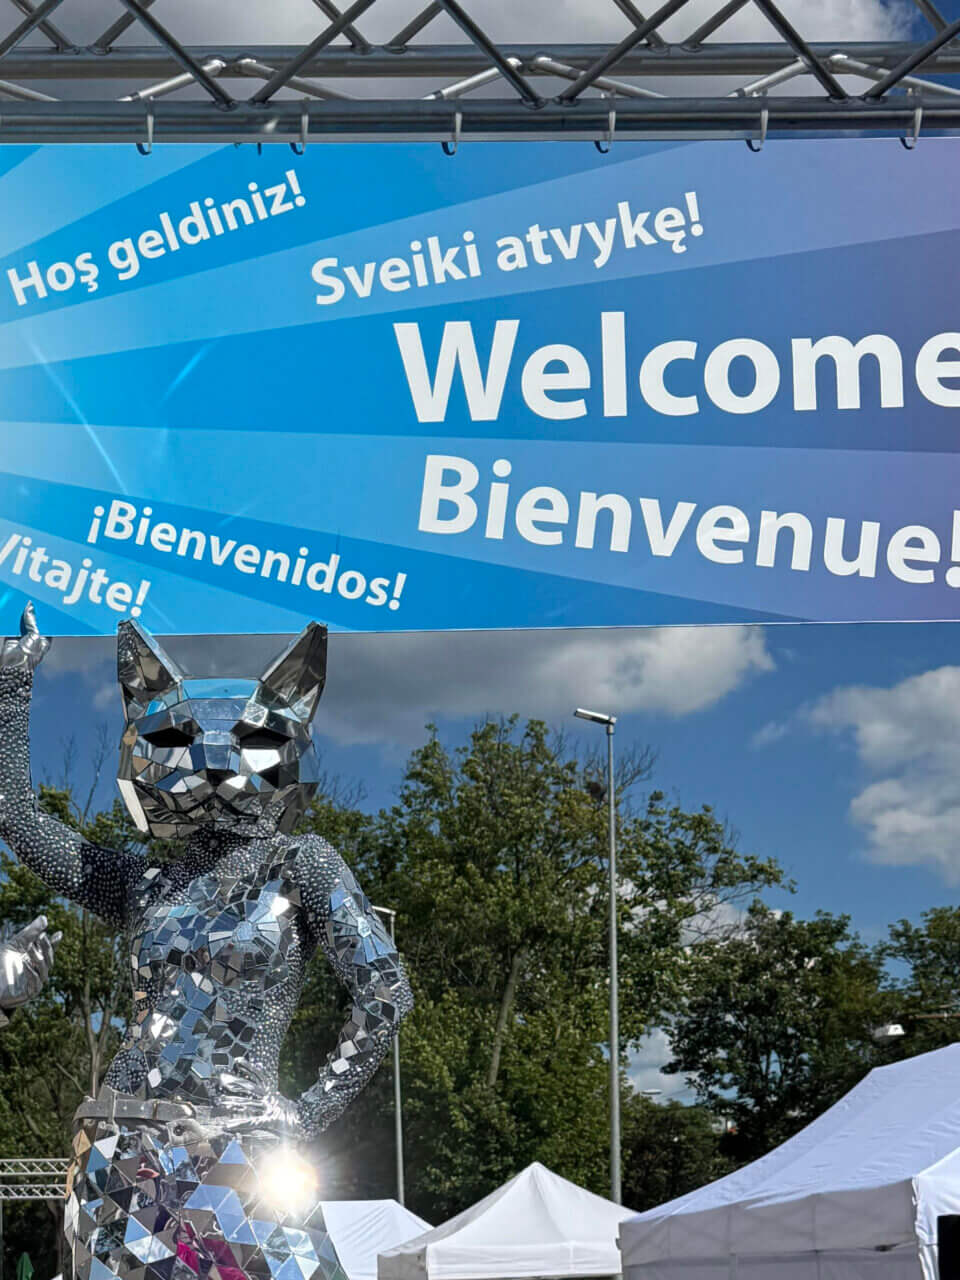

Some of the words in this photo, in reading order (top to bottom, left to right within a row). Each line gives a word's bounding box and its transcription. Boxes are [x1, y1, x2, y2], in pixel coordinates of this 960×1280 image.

[7, 256, 99, 306] Hoş
[108, 168, 307, 281] geldiniz!
[310, 231, 482, 305] Sveiki
[495, 191, 705, 269] atvykę!
[392, 311, 960, 423] Welcome
[87, 499, 408, 610] ¡Bienvenidos!
[417, 454, 960, 589] Bienvenue!
